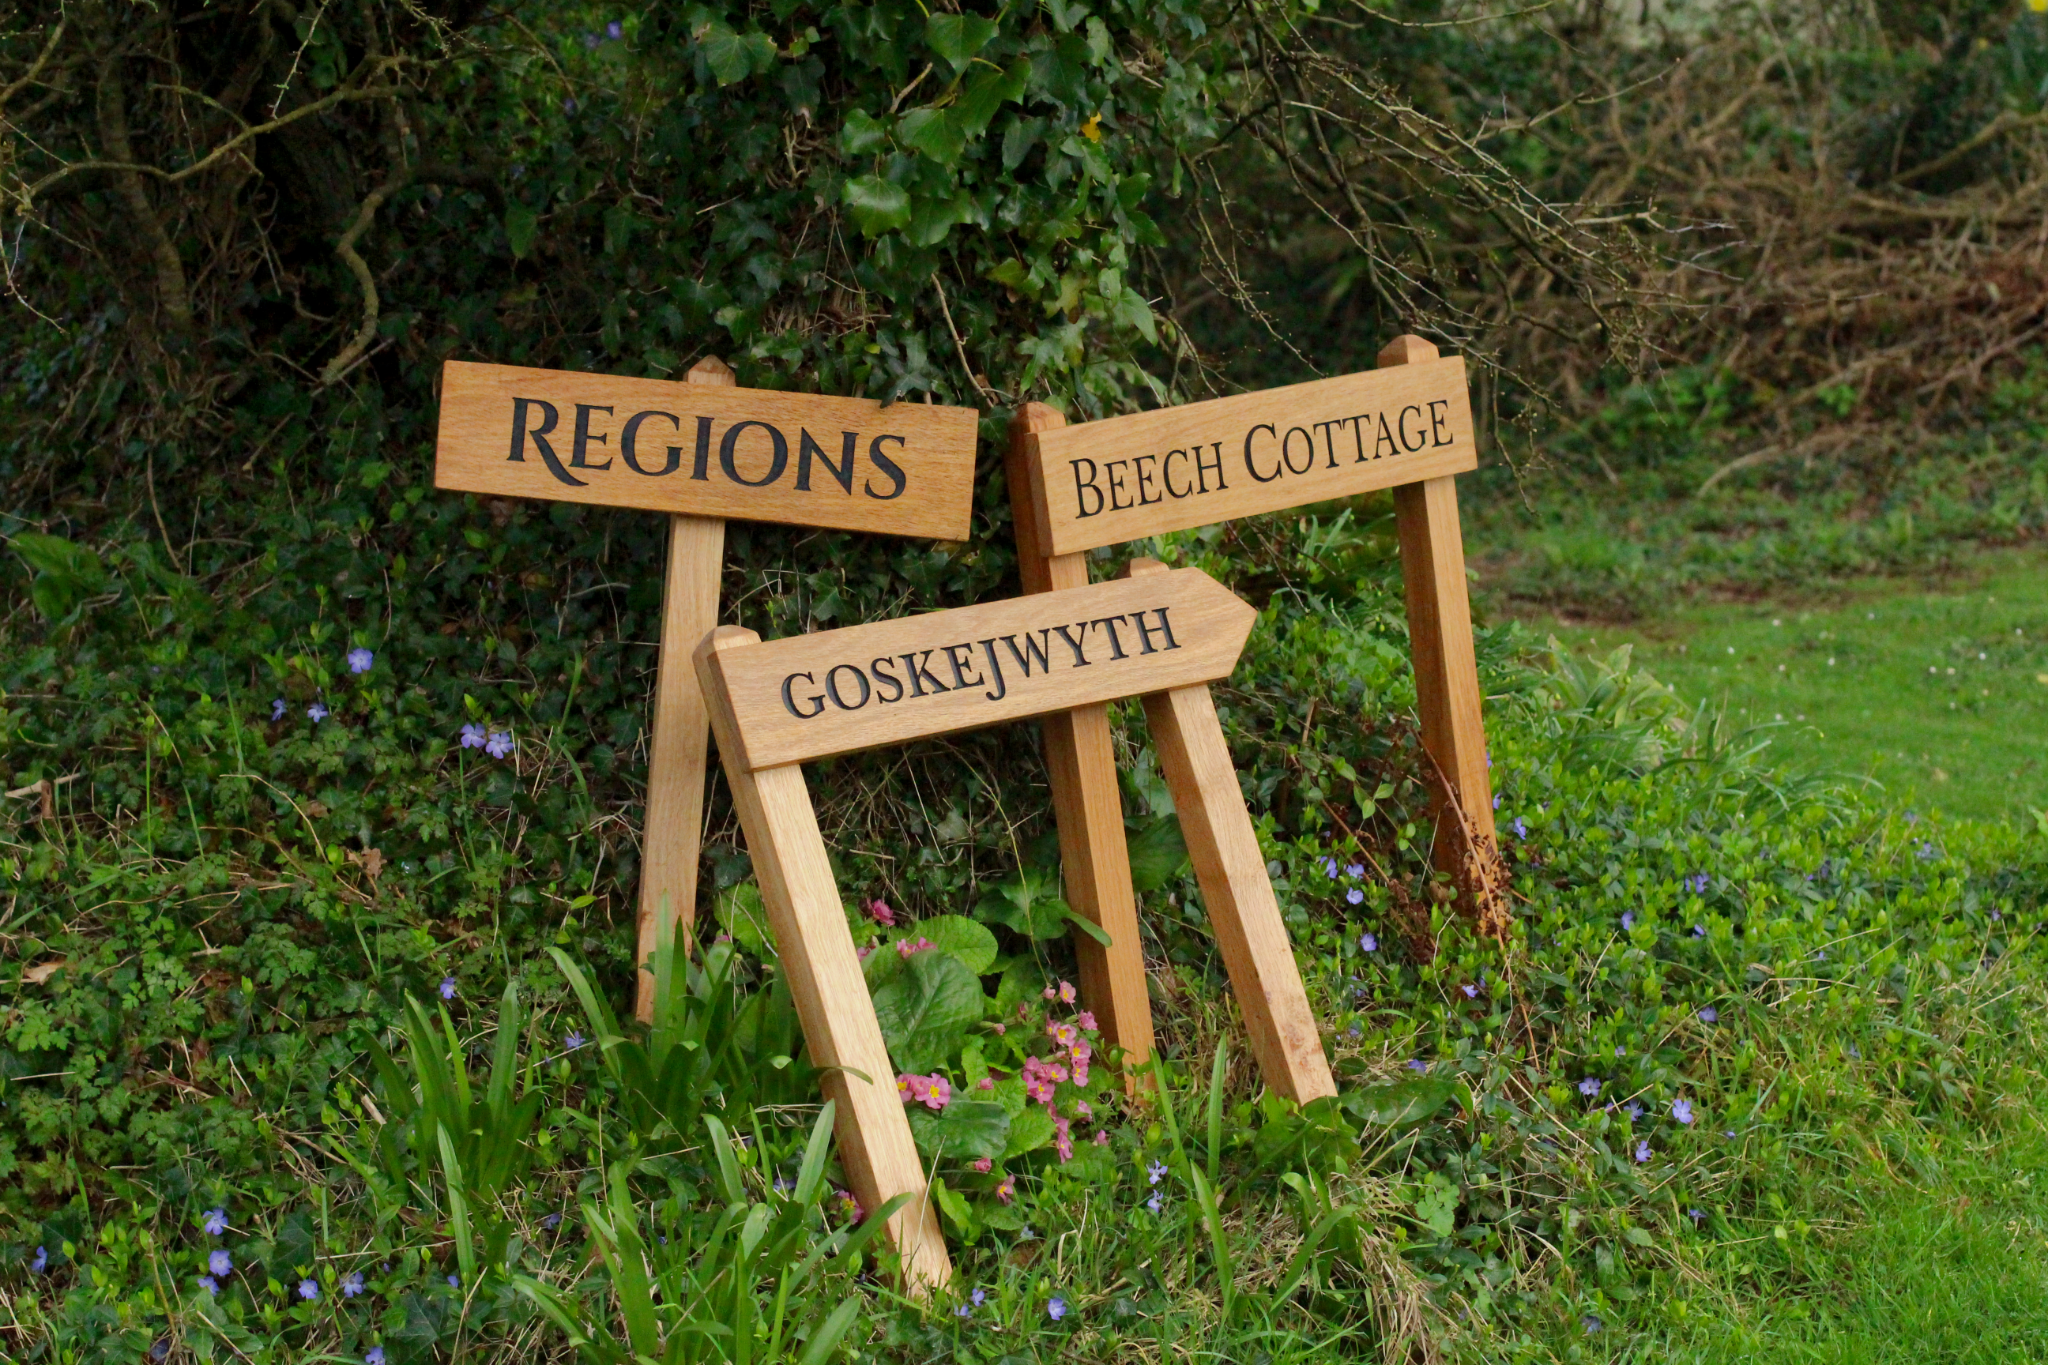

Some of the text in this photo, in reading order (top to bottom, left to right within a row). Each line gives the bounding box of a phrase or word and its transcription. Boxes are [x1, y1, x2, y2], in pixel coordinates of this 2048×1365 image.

[506, 396, 907, 500] REGIONS
[1068, 399, 1454, 519] BEECH COTTAGE
[780, 606, 1182, 720] GOSKEJWYTH
